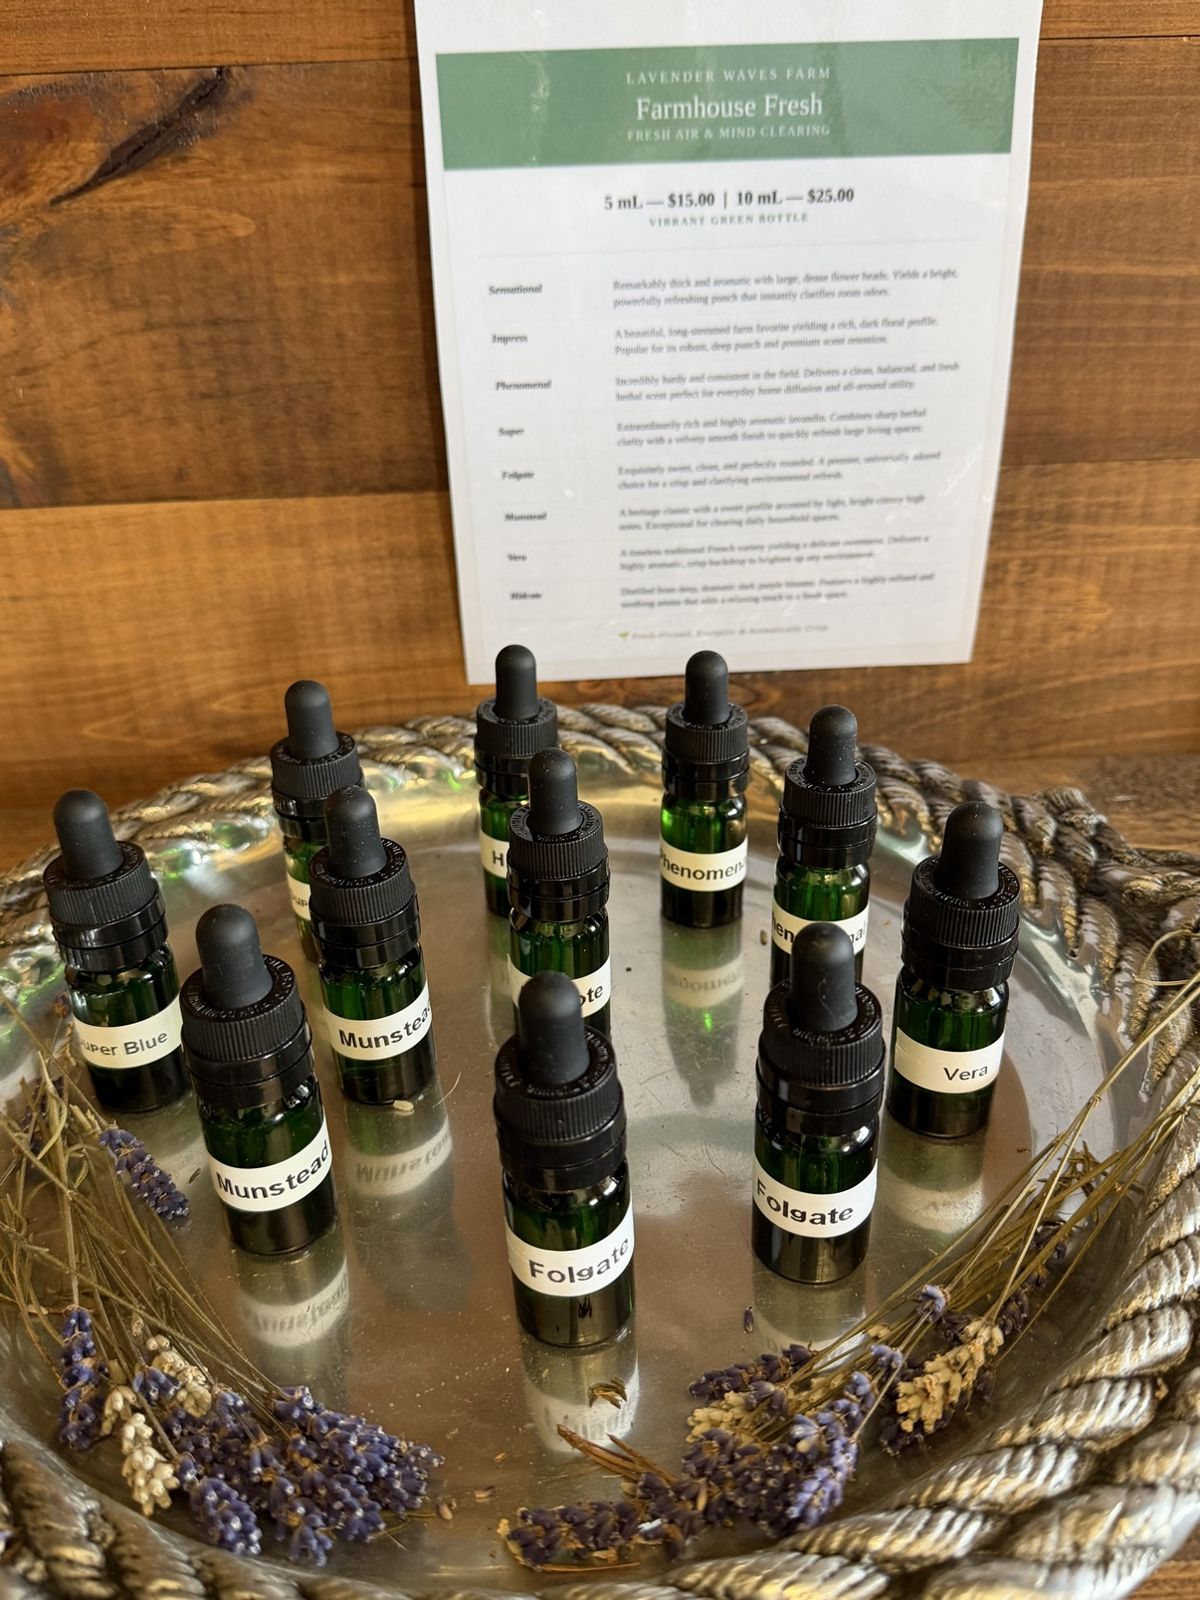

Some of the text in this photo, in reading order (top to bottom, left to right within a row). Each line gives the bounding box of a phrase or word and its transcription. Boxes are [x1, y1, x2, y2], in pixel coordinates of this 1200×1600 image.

[626, 67, 830, 85] LAVENDER WAVES FARM
[636, 92, 823, 120] Farmhouse Fresh
[627, 124, 831, 142] FRESH AIR & MIND CLEARING
[604, 195, 613, 210] 5
[618, 195, 644, 210] mL
[667, 192, 715, 209] $15.00
[737, 190, 753, 206] 10
[757, 189, 783, 205] mL
[807, 188, 855, 204] $25.00
[649, 212, 809, 228] VIBRANT GREEN BOTTLE
[488, 284, 543, 295] Sensational
[492, 334, 529, 345] Impress
[495, 380, 552, 391] Phenomenal
[338, 1007, 431, 1049] Munstea
[81, 1032, 168, 1056] uper Blue
[943, 1064, 989, 1082] Vera
[216, 1139, 329, 1200] Munstead
[757, 1178, 854, 1226] Folgate
[528, 1238, 629, 1284] Folgate
